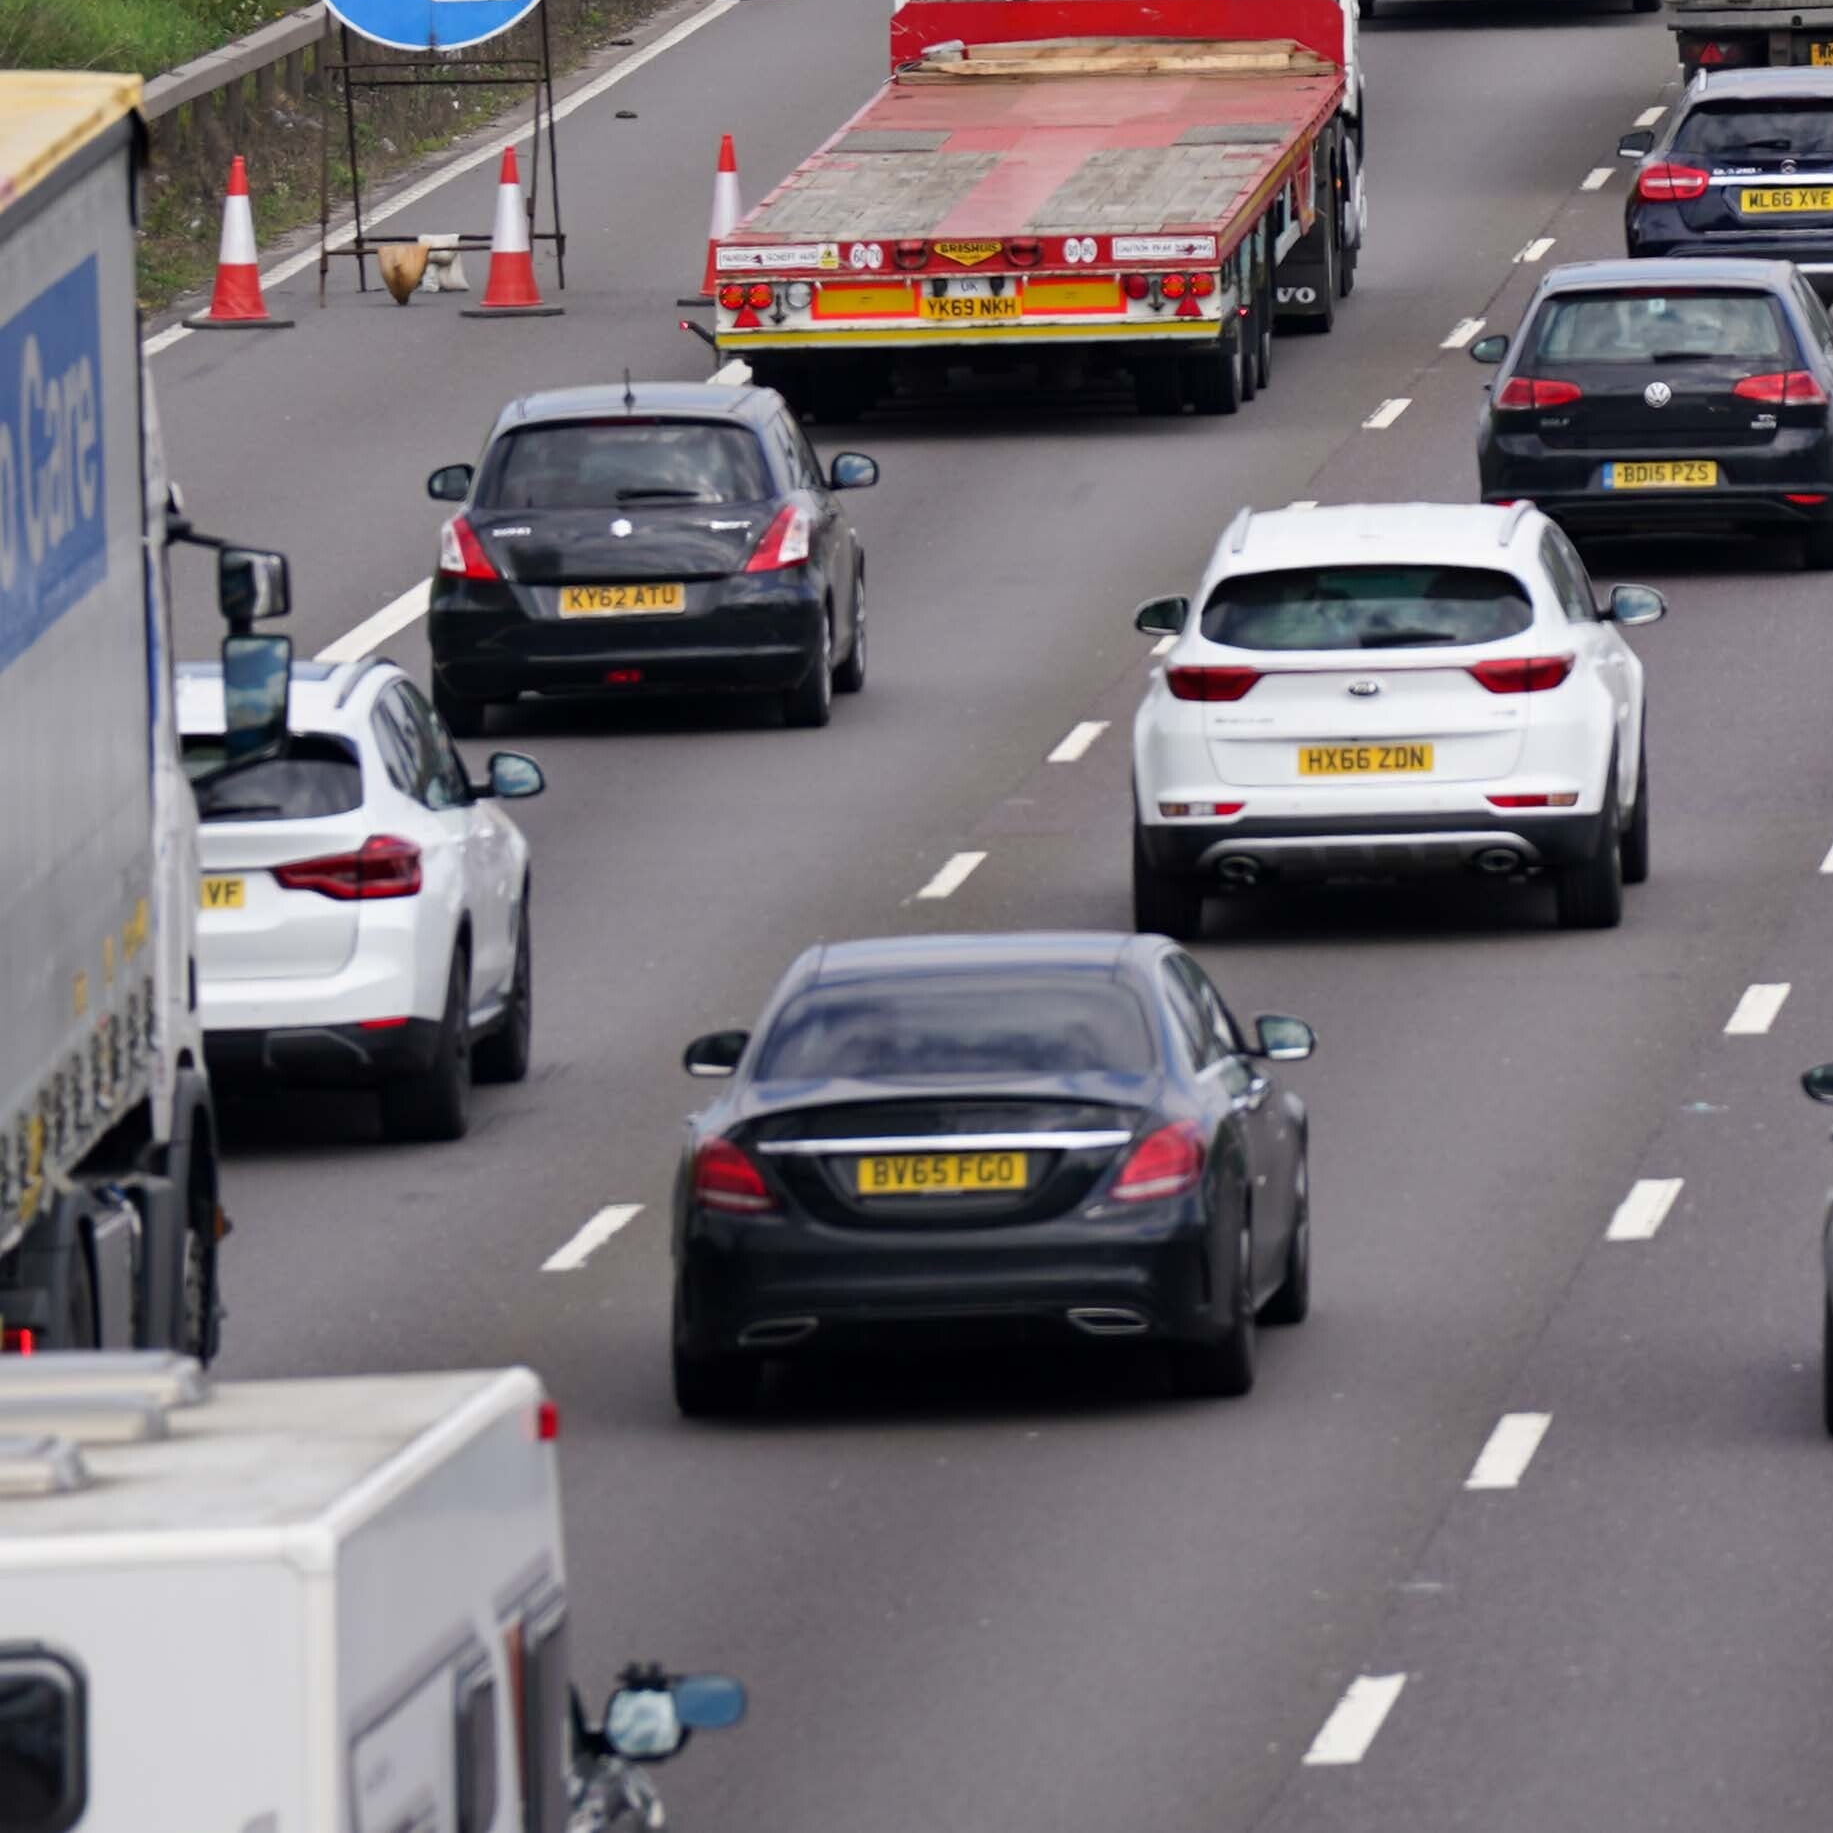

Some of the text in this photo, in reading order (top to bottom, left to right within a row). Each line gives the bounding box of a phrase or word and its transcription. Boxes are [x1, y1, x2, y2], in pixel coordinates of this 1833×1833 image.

[1798, 189, 1833, 207] XVE
[928, 298, 1018, 317] YK69 NKH
[20, 332, 99, 566] Care
[1623, 461, 1709, 483] BD15 PZS
[569, 586, 677, 608] KY62 ATU
[1307, 745, 1426, 773] HX66 ZDN
[872, 1157, 947, 1185] BV65
